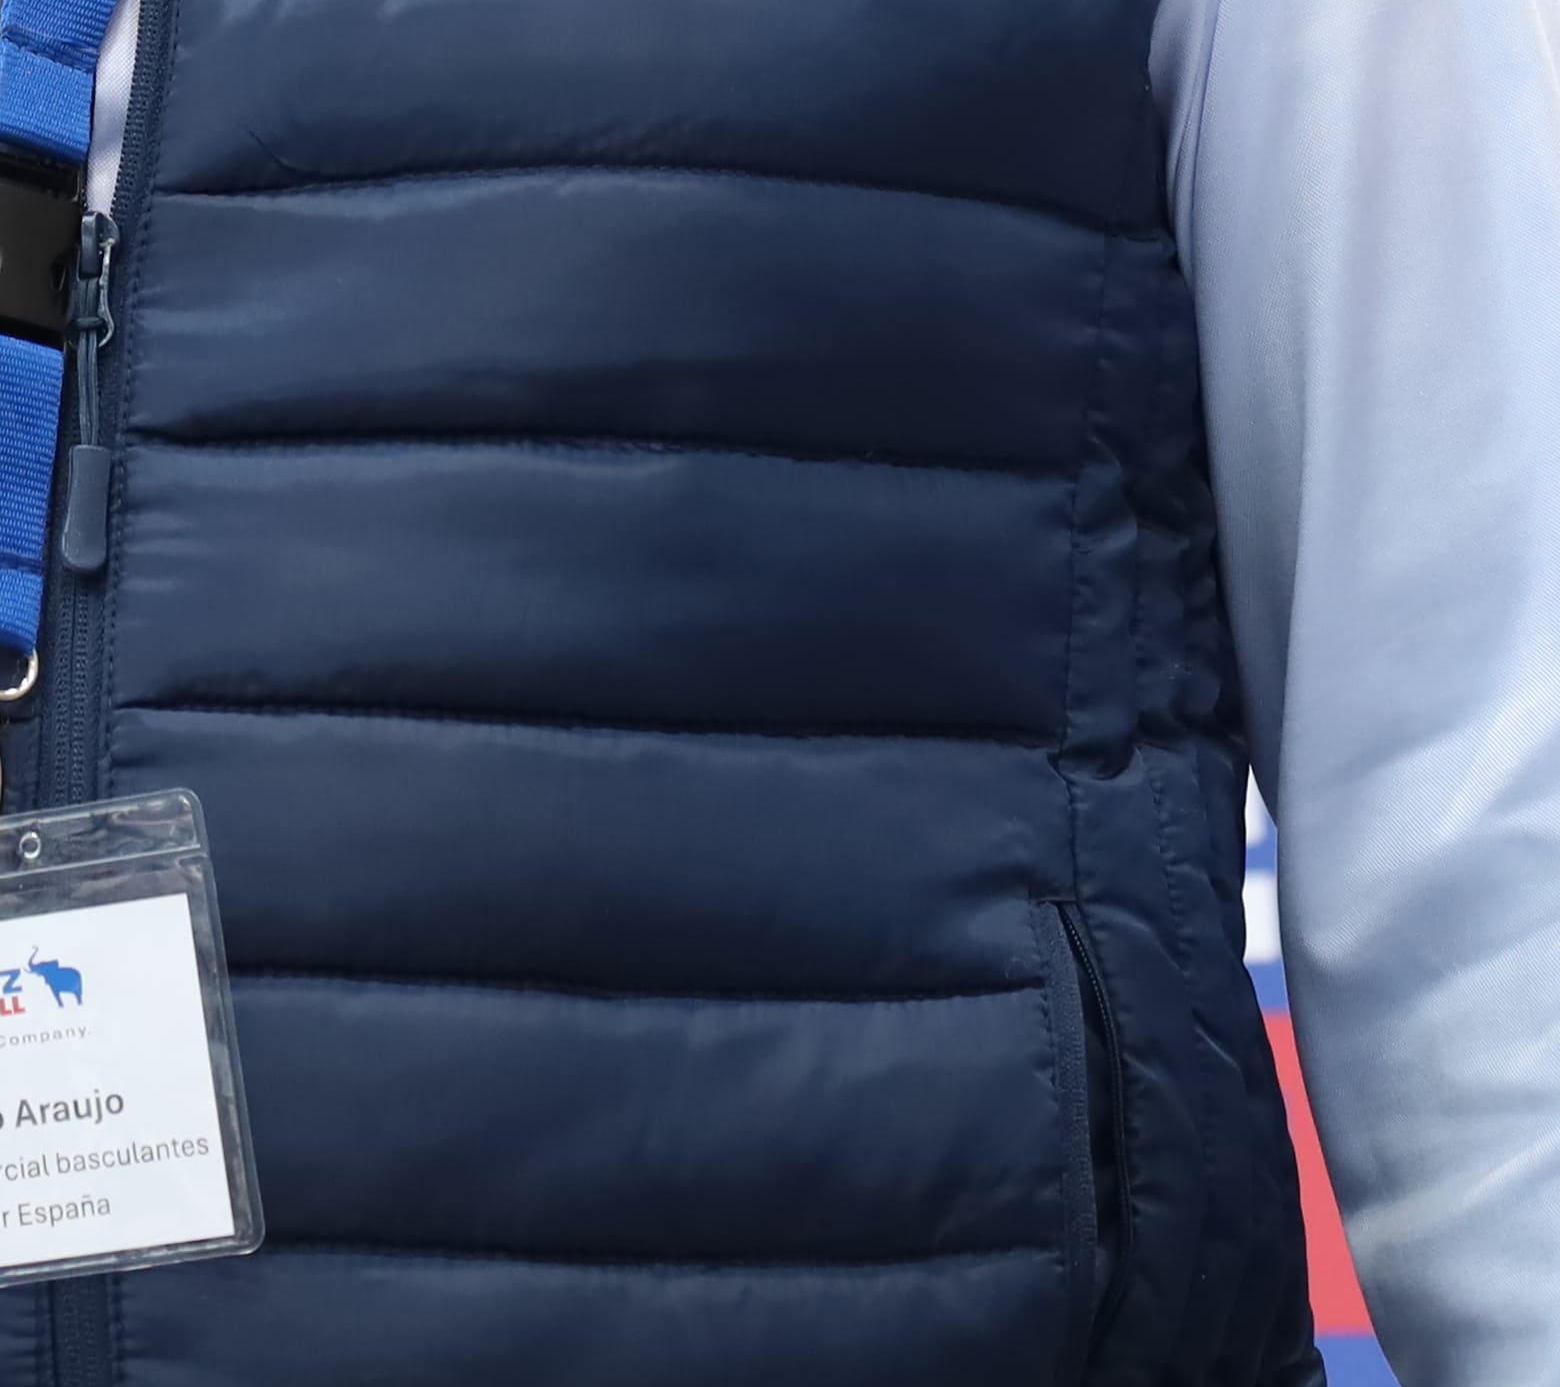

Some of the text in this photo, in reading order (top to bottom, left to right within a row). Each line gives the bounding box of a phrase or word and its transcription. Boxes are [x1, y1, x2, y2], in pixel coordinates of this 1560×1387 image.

[15, 1088, 126, 1127] Araujo
[56, 1134, 210, 1174] basculantes
[18, 1193, 112, 1228] España
